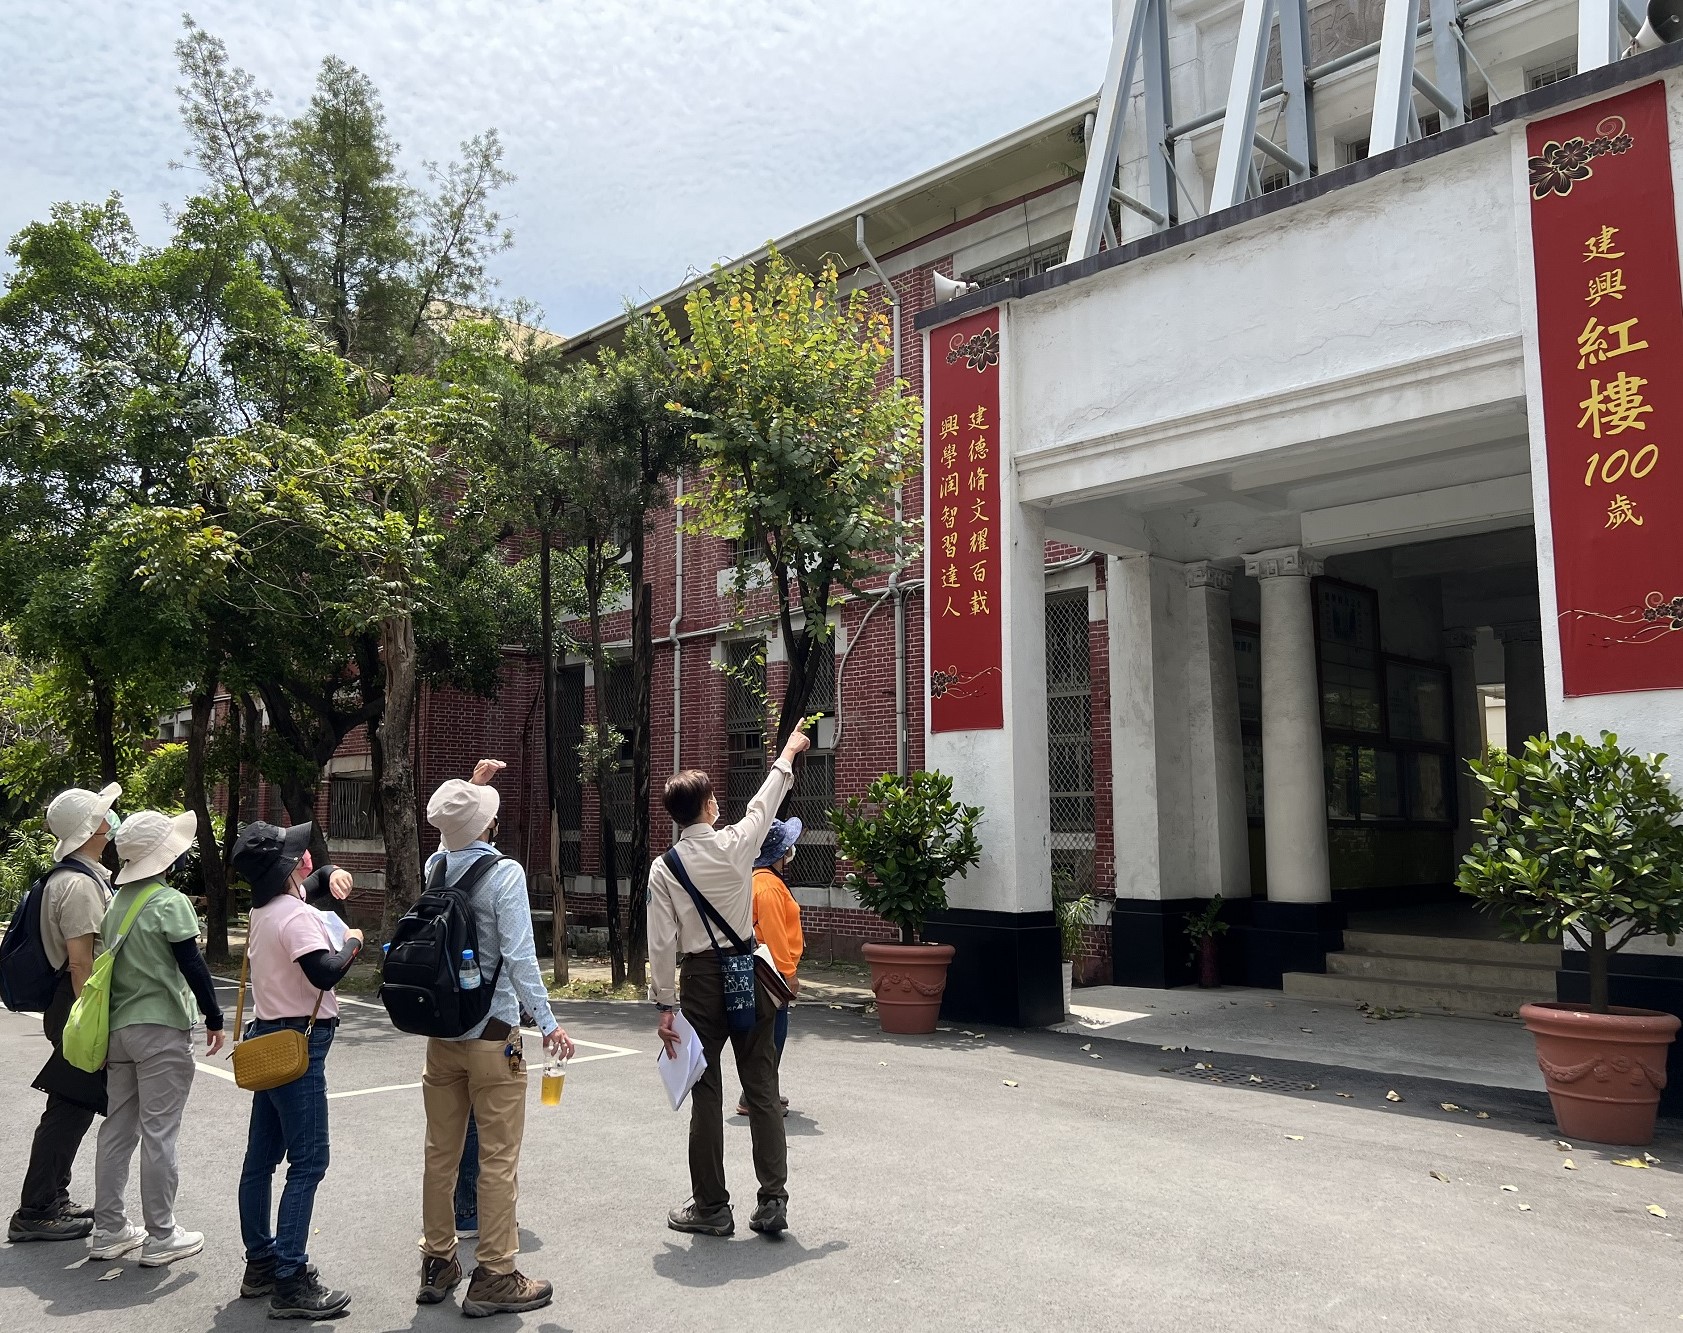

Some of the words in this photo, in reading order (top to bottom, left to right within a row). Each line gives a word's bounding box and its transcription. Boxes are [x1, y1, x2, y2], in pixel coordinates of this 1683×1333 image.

[939, 413, 961, 618] 興學潤智習達人
